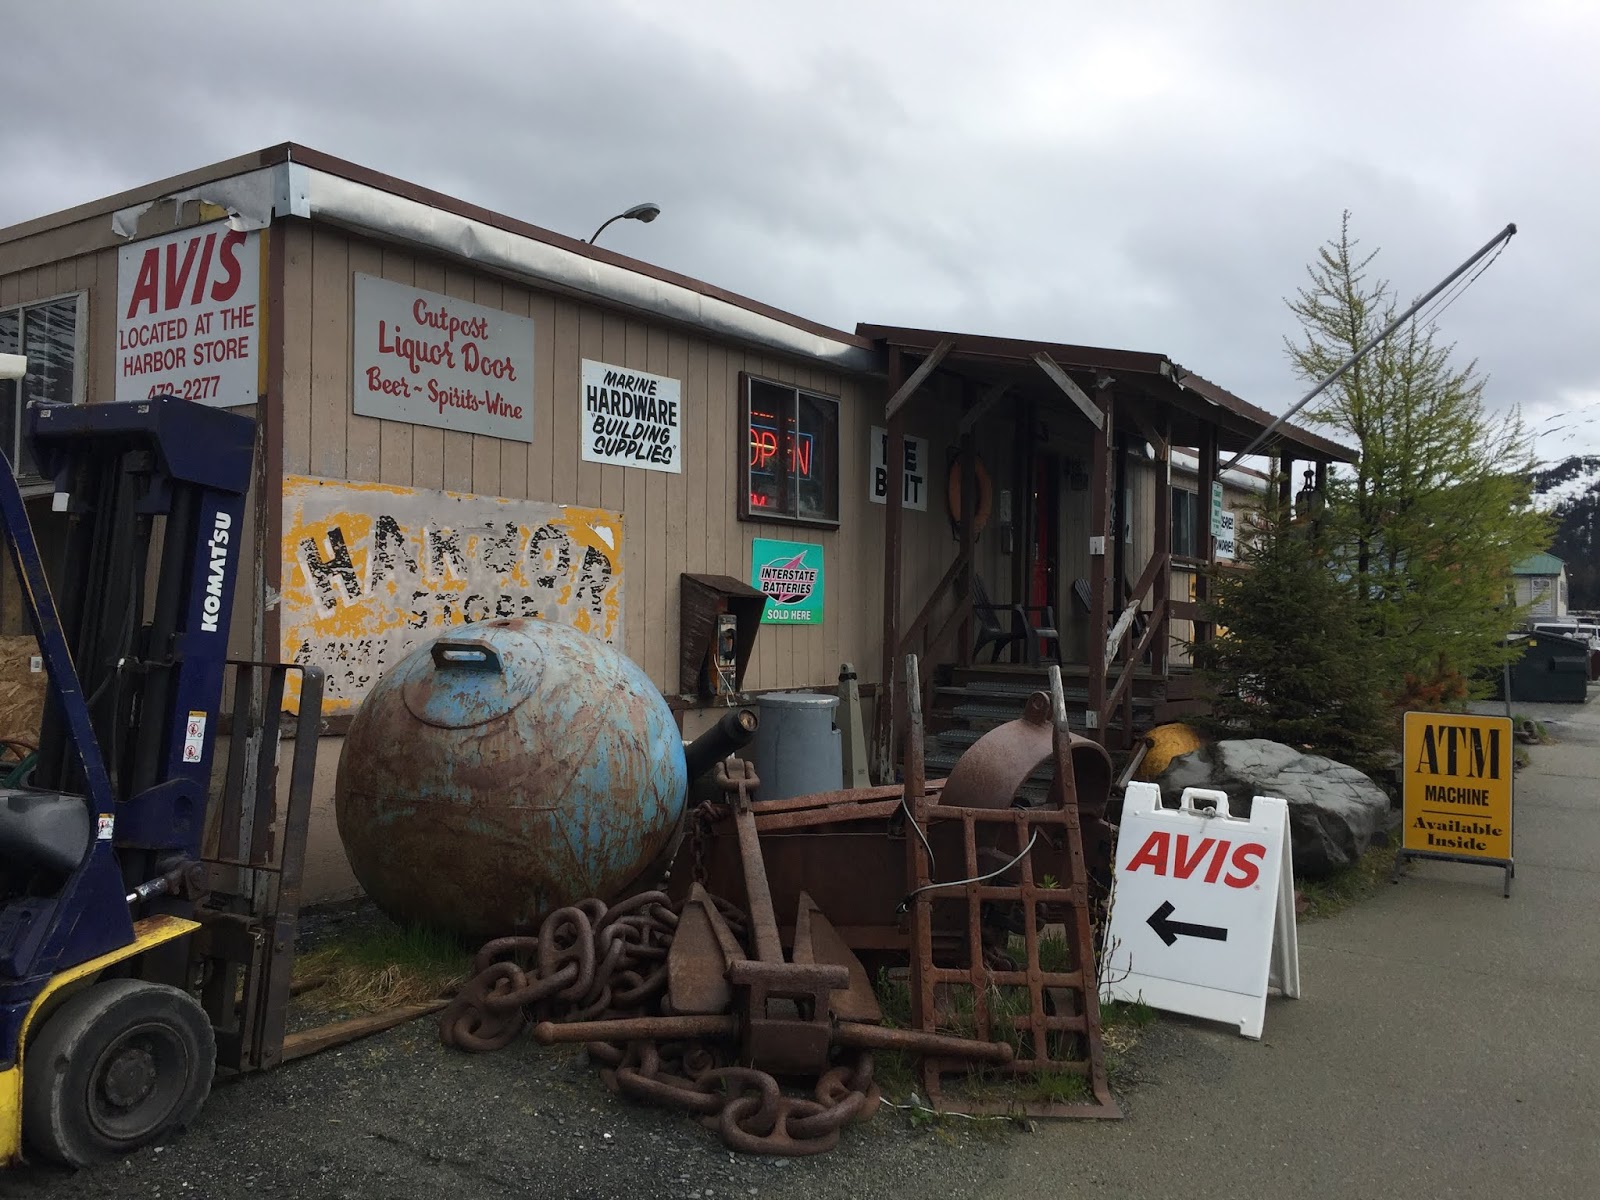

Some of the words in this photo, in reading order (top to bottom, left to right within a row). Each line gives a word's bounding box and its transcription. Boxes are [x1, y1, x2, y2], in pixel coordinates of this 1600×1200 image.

[127, 229, 247, 319] AVIS
[119, 317, 187, 350] LOCATED
[194, 312, 213, 336] AT
[220, 304, 256, 330] THE
[413, 298, 488, 342] Outpost
[124, 347, 186, 377] HARBOR
[193, 336, 249, 366] STORE
[379, 320, 455, 374] Liquor
[461, 342, 517, 382] Door
[587, 385, 677, 427] HARDWARE
[882, 434, 917, 472] TE
[875, 467, 923, 504] BIT
[201, 511, 232, 632] KOMATSU
[761, 567, 815, 581] INTERSTATE
[763, 581, 811, 594] BATTERIES
[767, 609, 789, 620] SOLD
[791, 610, 811, 621] HERE
[1414, 724, 1502, 780] ATM
[1425, 785, 1489, 807] MACHINE
[1413, 816, 1503, 837] Available
[1428, 833, 1487, 851] Inside
[1125, 831, 1267, 889] AVIS
